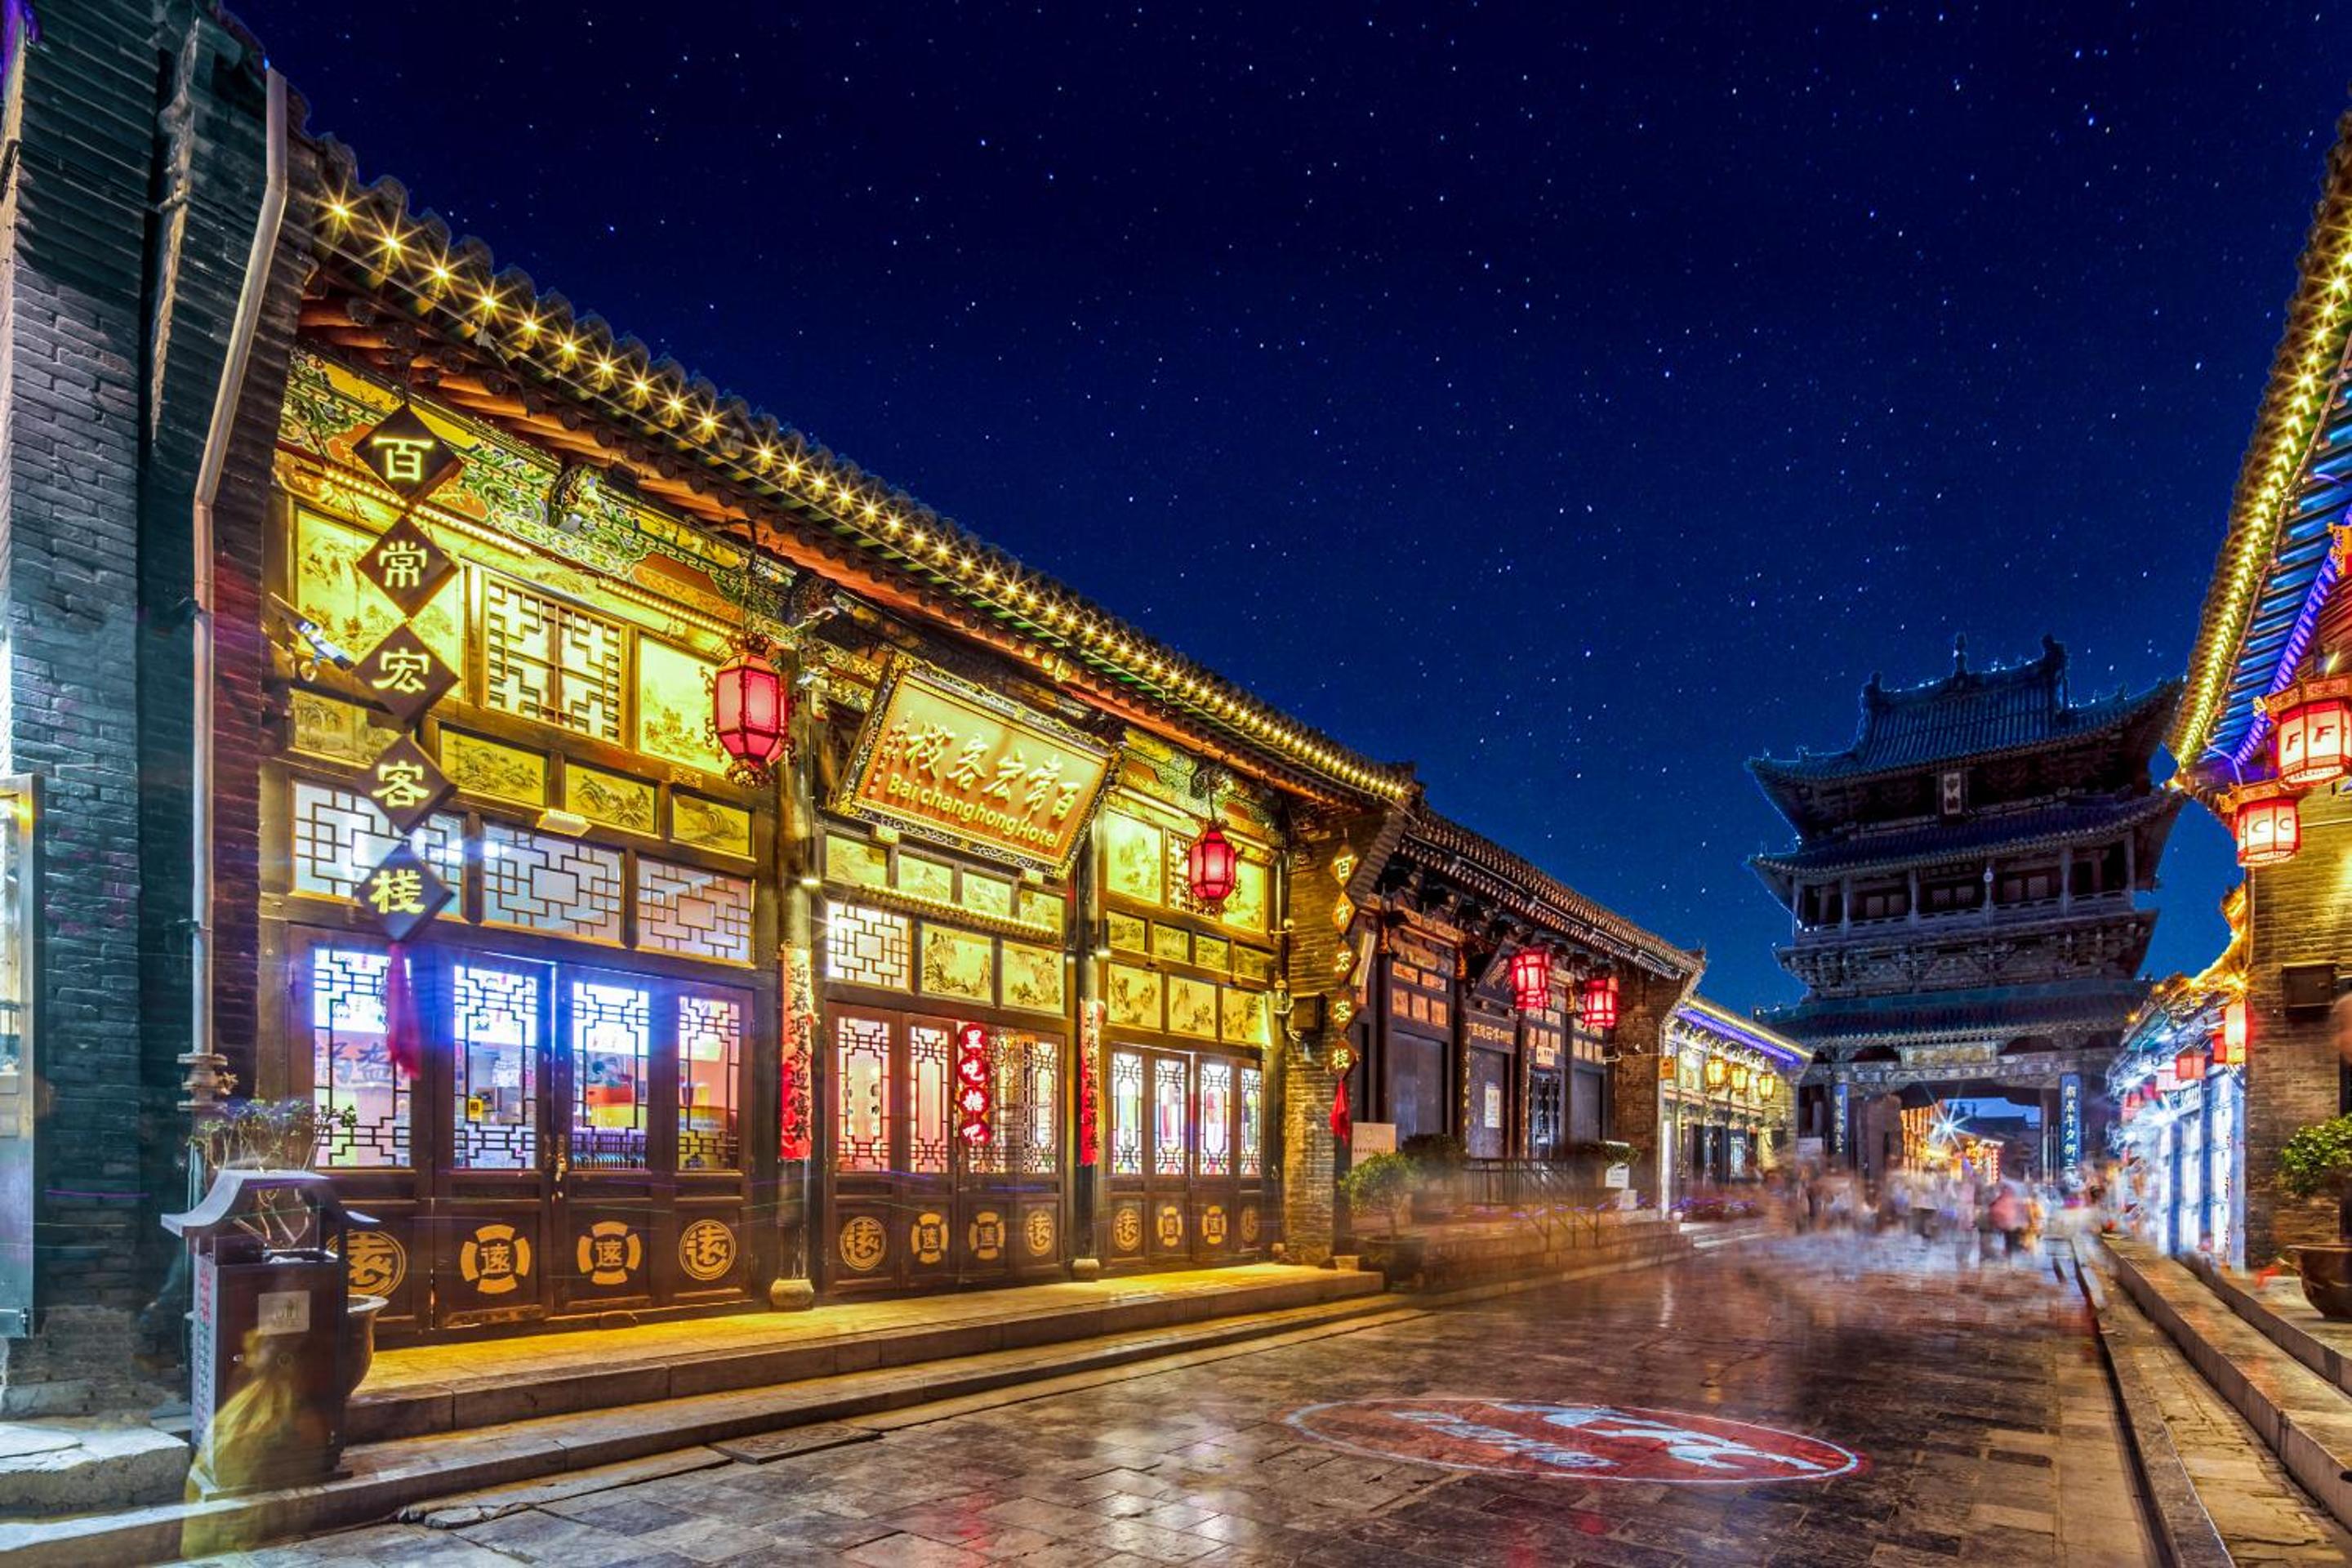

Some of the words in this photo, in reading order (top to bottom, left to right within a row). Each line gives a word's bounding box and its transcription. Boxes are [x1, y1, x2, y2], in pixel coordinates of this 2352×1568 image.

[369, 434, 434, 915] 百常宏客栈
[1017, 818, 1063, 848] Hotel
